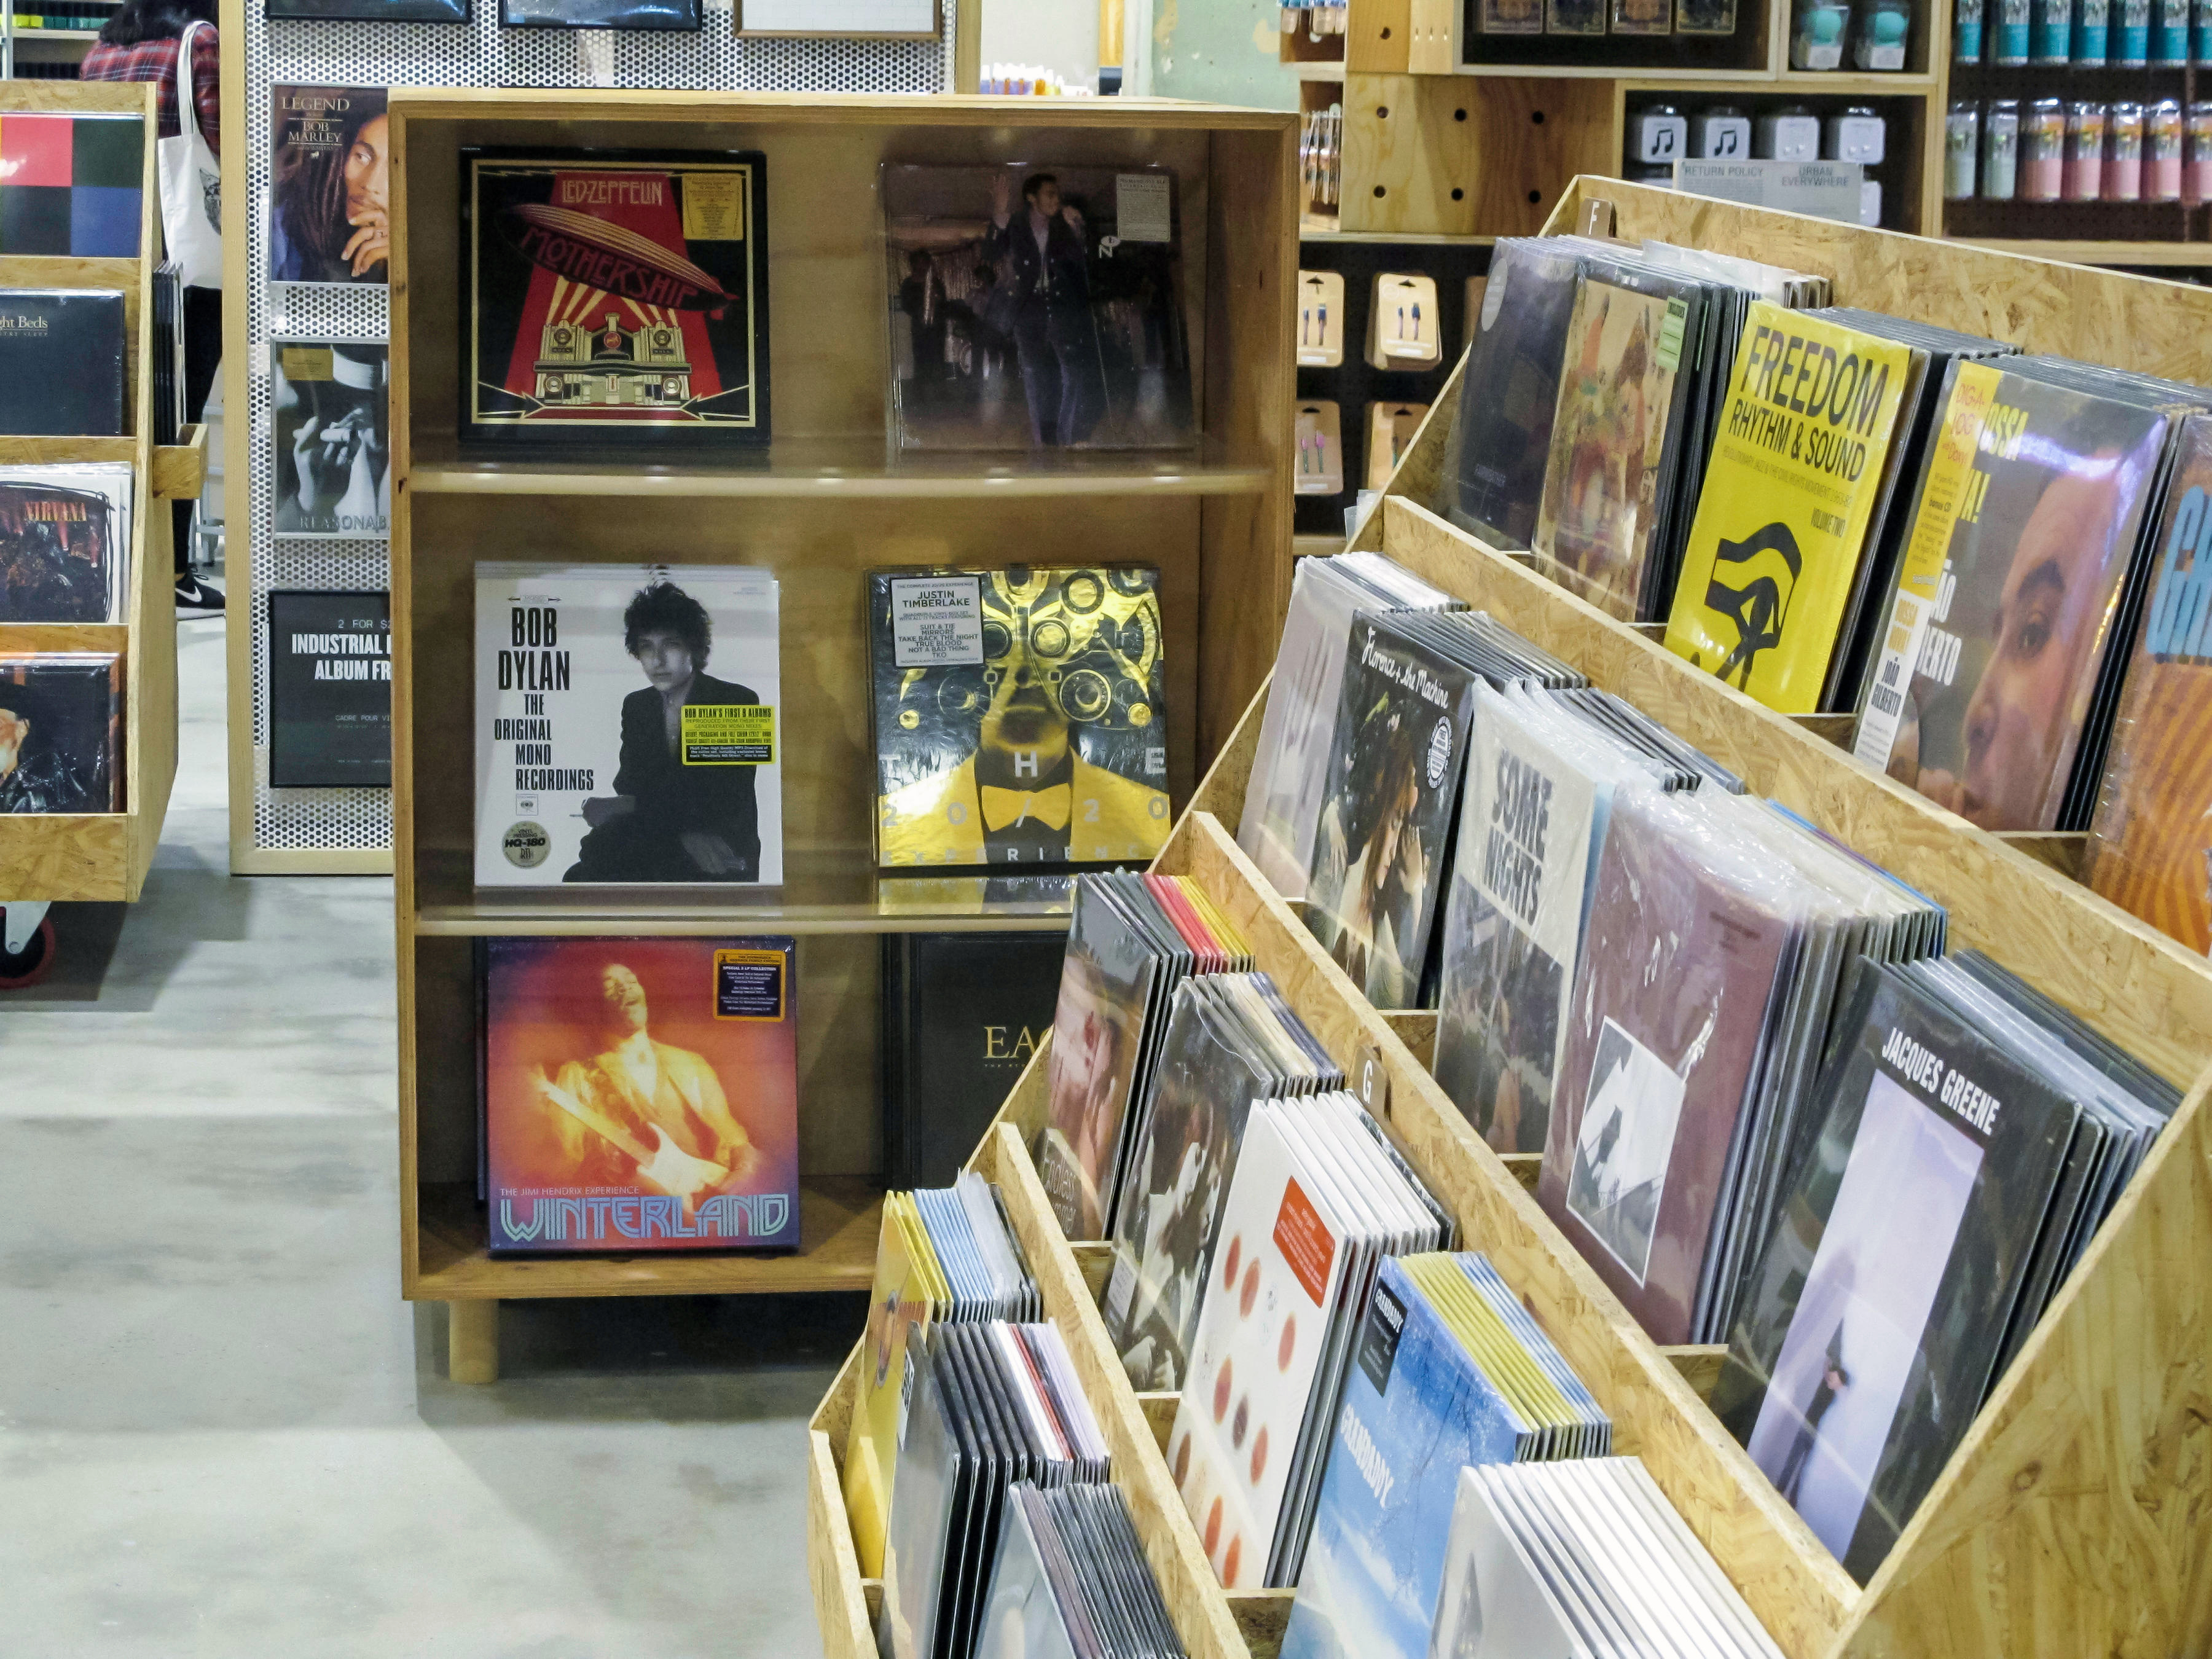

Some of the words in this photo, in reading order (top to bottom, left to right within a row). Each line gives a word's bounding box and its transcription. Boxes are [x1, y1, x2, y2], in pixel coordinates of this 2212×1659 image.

[281, 96, 350, 111] LEGEND
[303, 121, 329, 131] BOB
[289, 131, 342, 143] MARLEY
[1684, 167, 1725, 176] RETURN
[1728, 167, 1763, 176] POLICY
[1782, 176, 1849, 187] EVERYWHERE
[1799, 167, 1834, 176] URBAN
[520, 226, 699, 307] MOTHERSHIP
[18, 315, 49, 329] Beds
[1739, 326, 1889, 437] FREEDOM
[1728, 399, 1792, 456] RHYTHM
[1790, 422, 1804, 460] &
[1805, 426, 1866, 482] SOUND
[25, 501, 87, 522] NIRVANA
[300, 515, 390, 531] REASONAB
[902, 598, 970, 608] TIMBERLAKE
[918, 590, 955, 600] JUSTIN
[338, 619, 344, 629] 2
[353, 619, 374, 629] FOR
[511, 606, 557, 647] BOB
[292, 633, 383, 654] INDUSTRIAL
[314, 659, 369, 680] ALBUM
[498, 650, 570, 691] DYLAN
[1362, 626, 1397, 678] Florence
[1400, 662, 1416, 691] the
[1415, 669, 1449, 709] Machine
[524, 694, 544, 715] THE
[1870, 682, 1902, 718] GILBERTO
[684, 708, 696, 718] BOB
[698, 708, 723, 718] DYLAN'S
[724, 708, 740, 718] FIRST
[748, 708, 771, 718] ALBUMS
[494, 719, 552, 741] ORIGINAL
[516, 744, 551, 766] MONO
[516, 769, 594, 791] RECORDINGS
[1491, 747, 1553, 863] SOME
[504, 837, 546, 847] HQ-180
[1483, 825, 1542, 927] NIGHTS
[1362, 1060, 1373, 1104] G
[1881, 1027, 1944, 1094] JACQUES
[1940, 1069, 2001, 1136] GREENE
[541, 1187, 582, 1196] HENDRIX
[585, 1186, 640, 1195] EXPERIENCE
[500, 1193, 789, 1242] WINTERLAND
